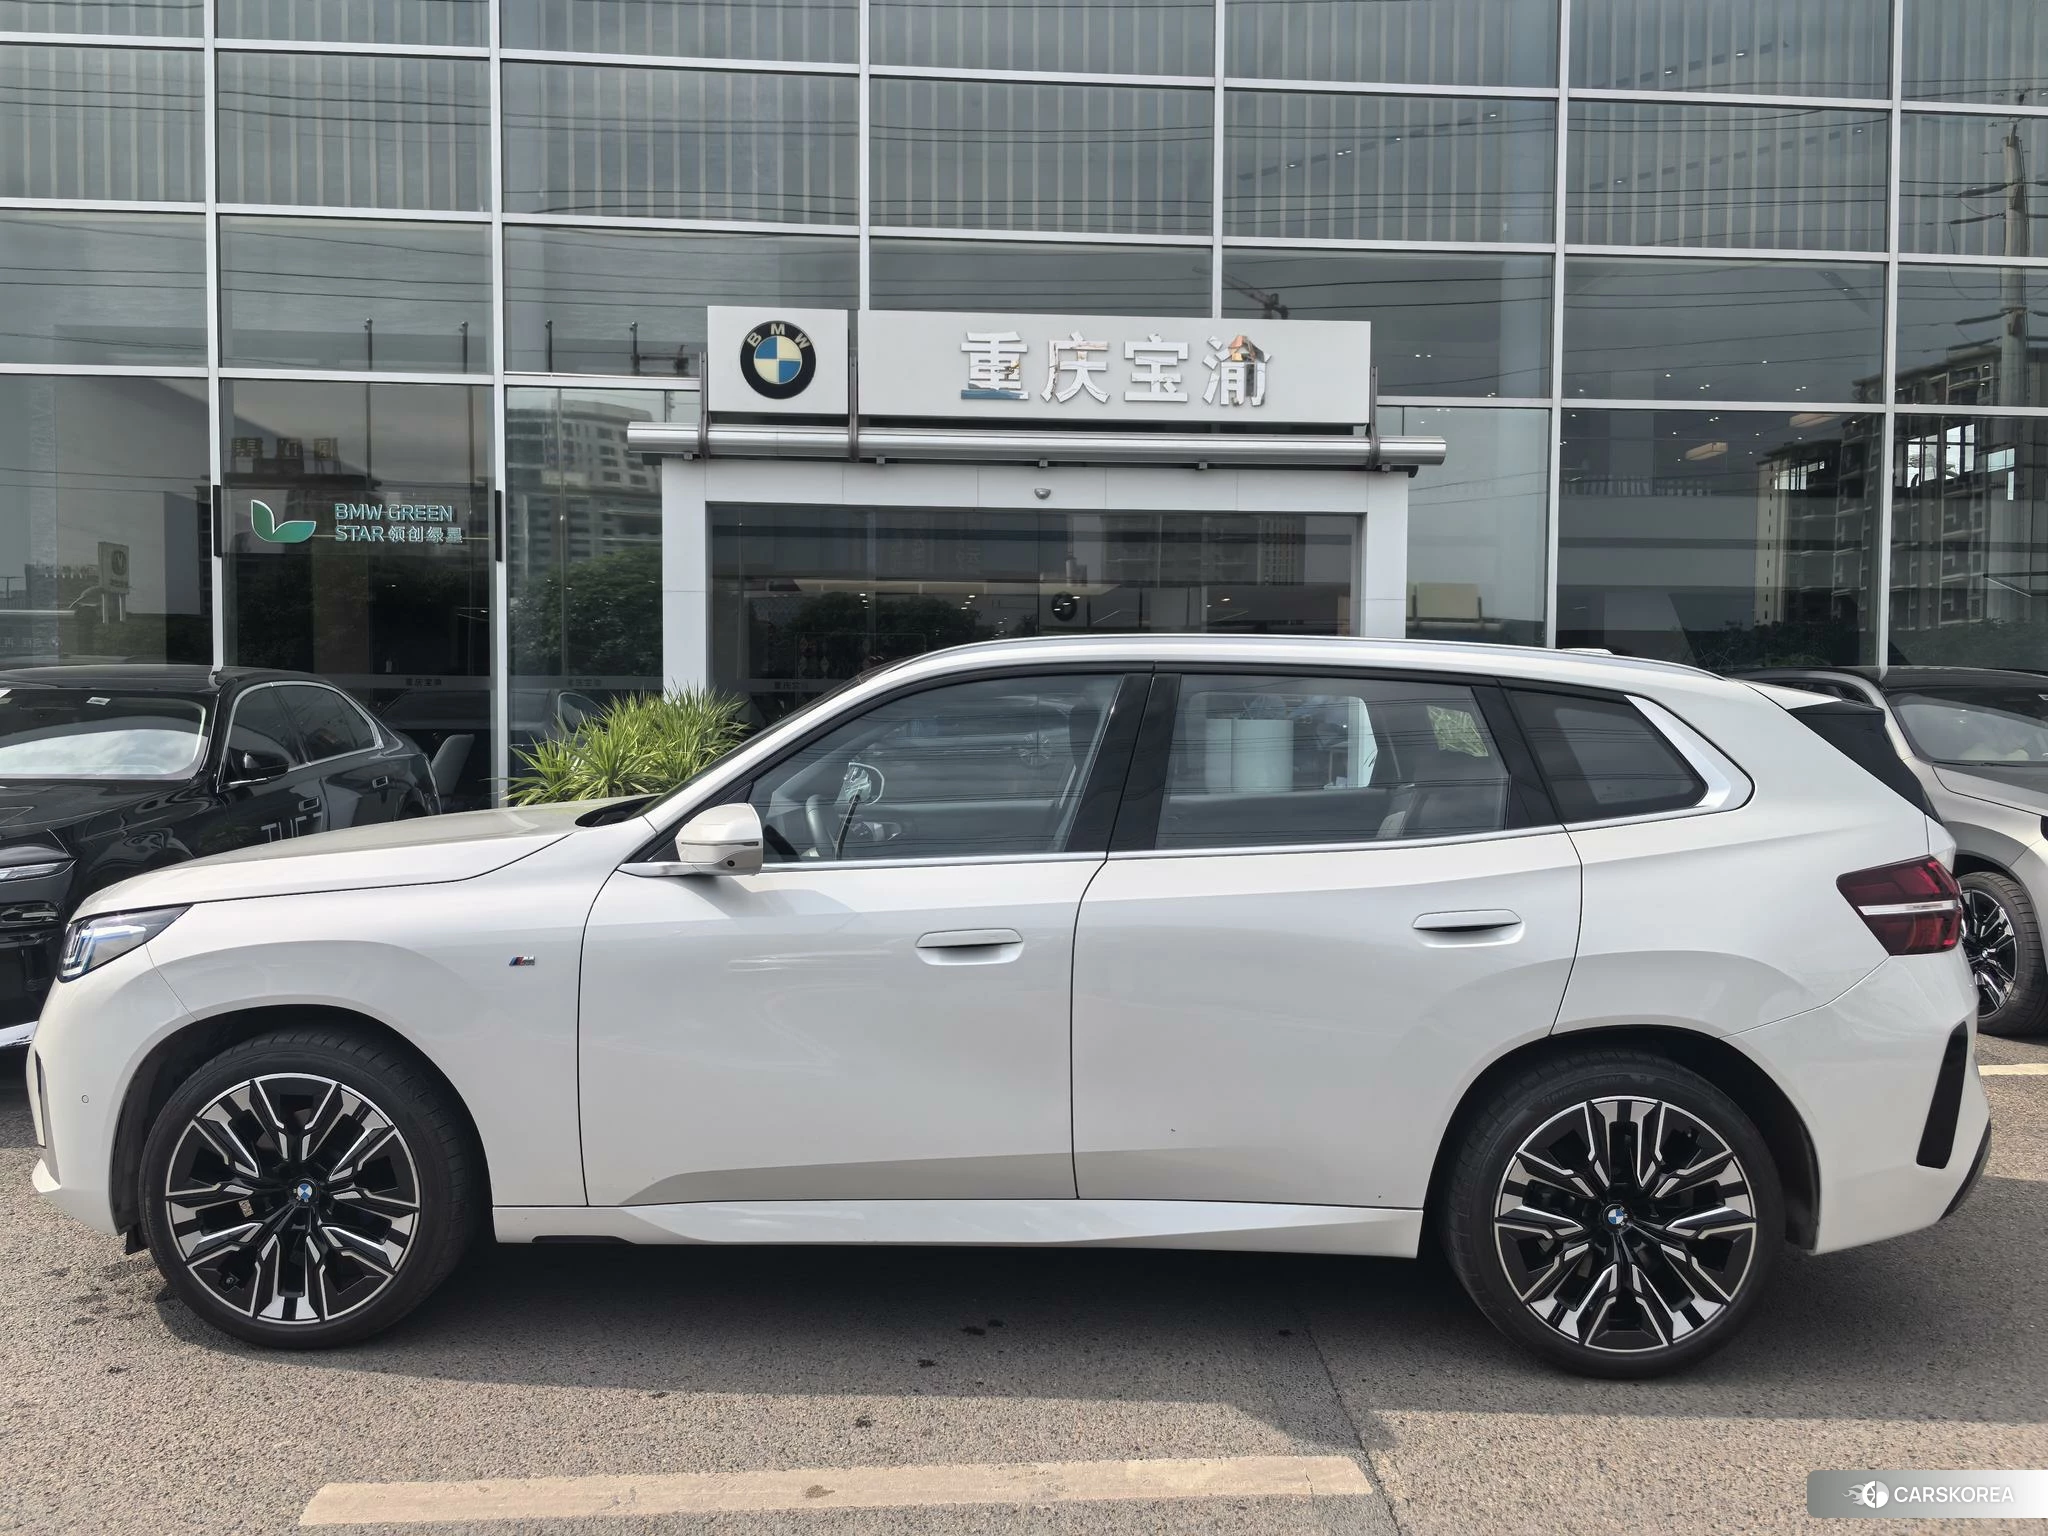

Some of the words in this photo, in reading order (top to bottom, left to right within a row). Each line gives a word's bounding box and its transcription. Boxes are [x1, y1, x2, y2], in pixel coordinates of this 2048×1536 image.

[746, 323, 812, 350] BMW
[960, 331, 1272, 407] 重庆宝渝
[335, 503, 383, 520] BMW
[388, 504, 453, 522] GREEN
[336, 525, 385, 542] STAR
